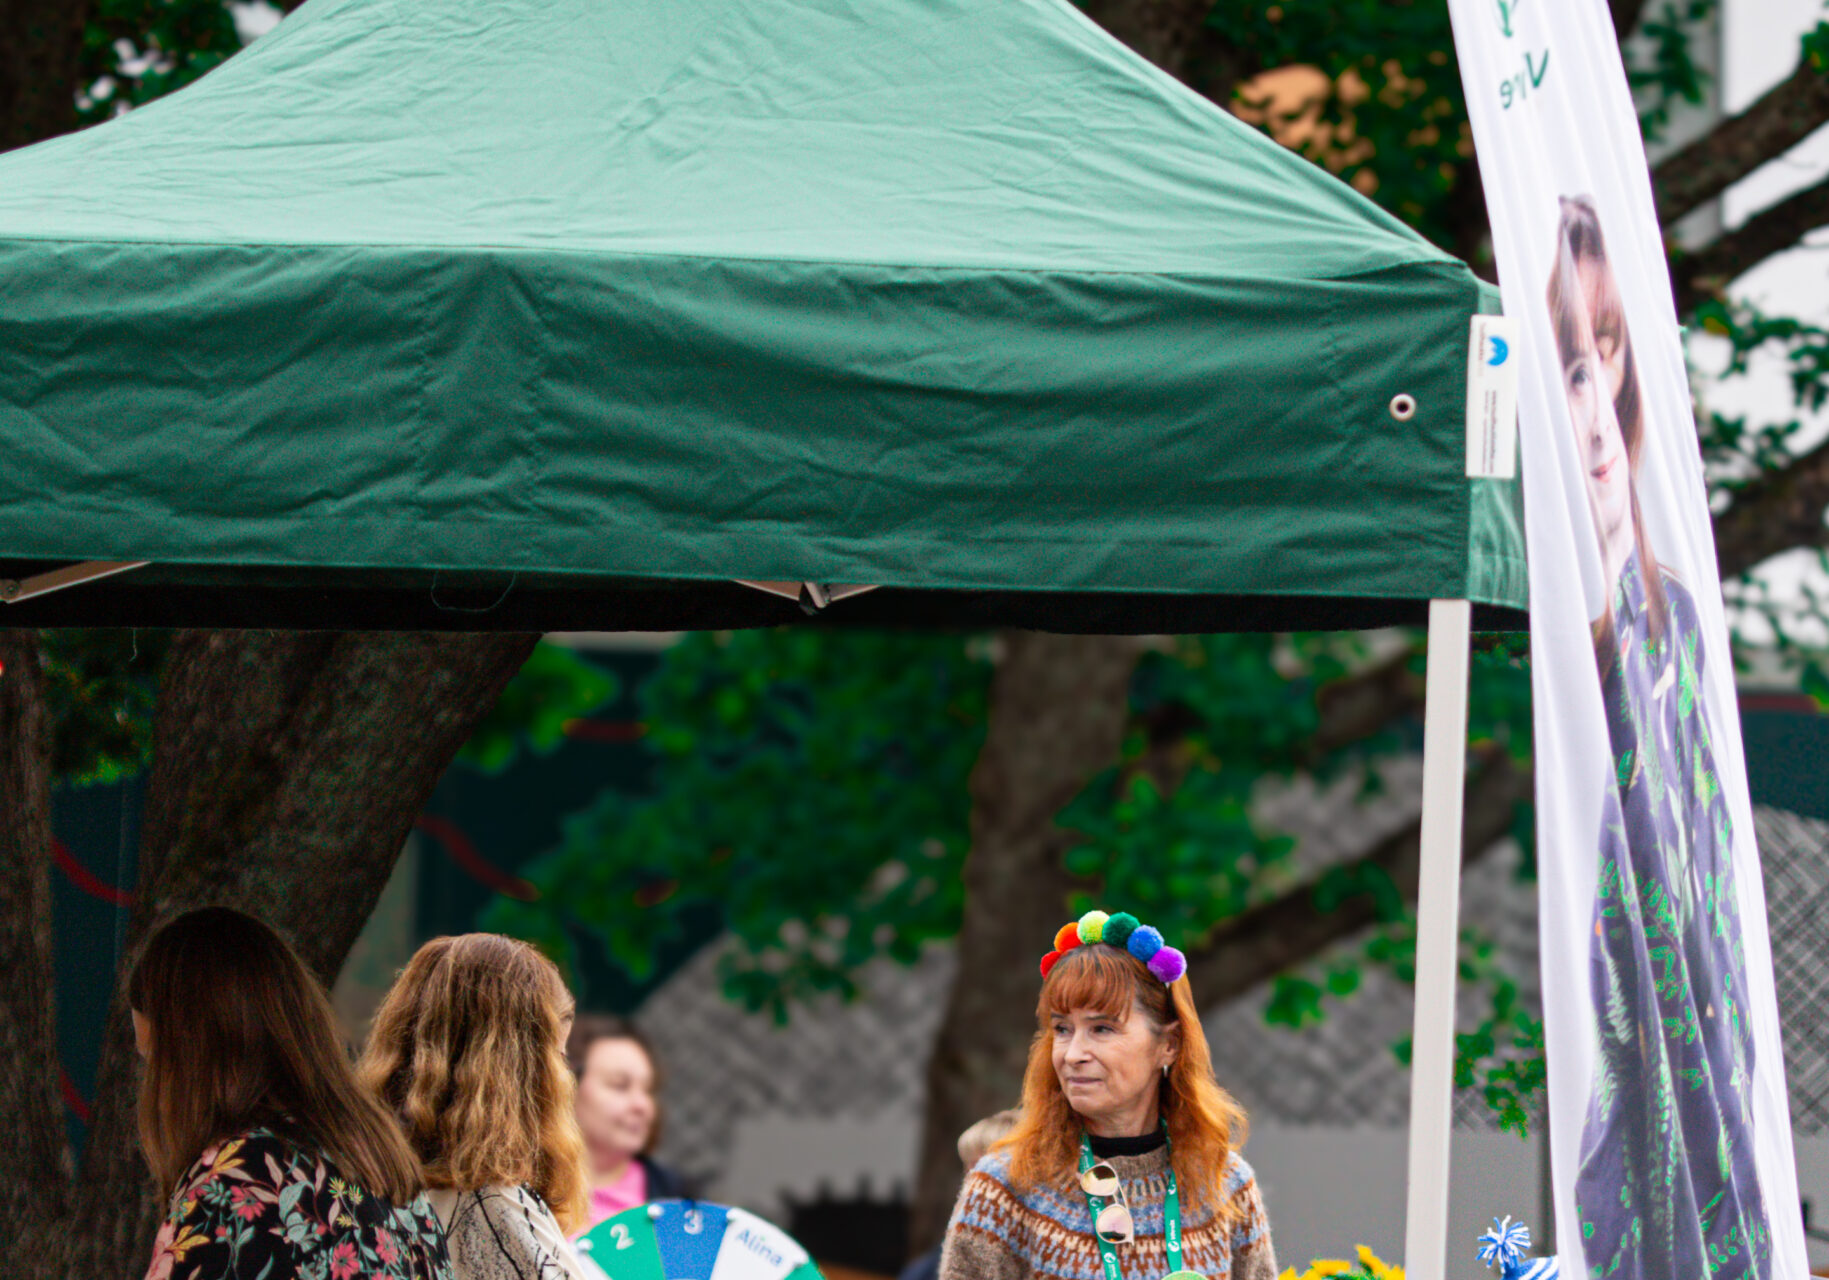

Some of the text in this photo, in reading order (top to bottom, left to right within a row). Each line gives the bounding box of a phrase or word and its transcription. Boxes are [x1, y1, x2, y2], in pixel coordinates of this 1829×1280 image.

[683, 1210, 704, 1235] 3
[610, 1223, 634, 1249] 2
[735, 1229, 784, 1267] Alina
